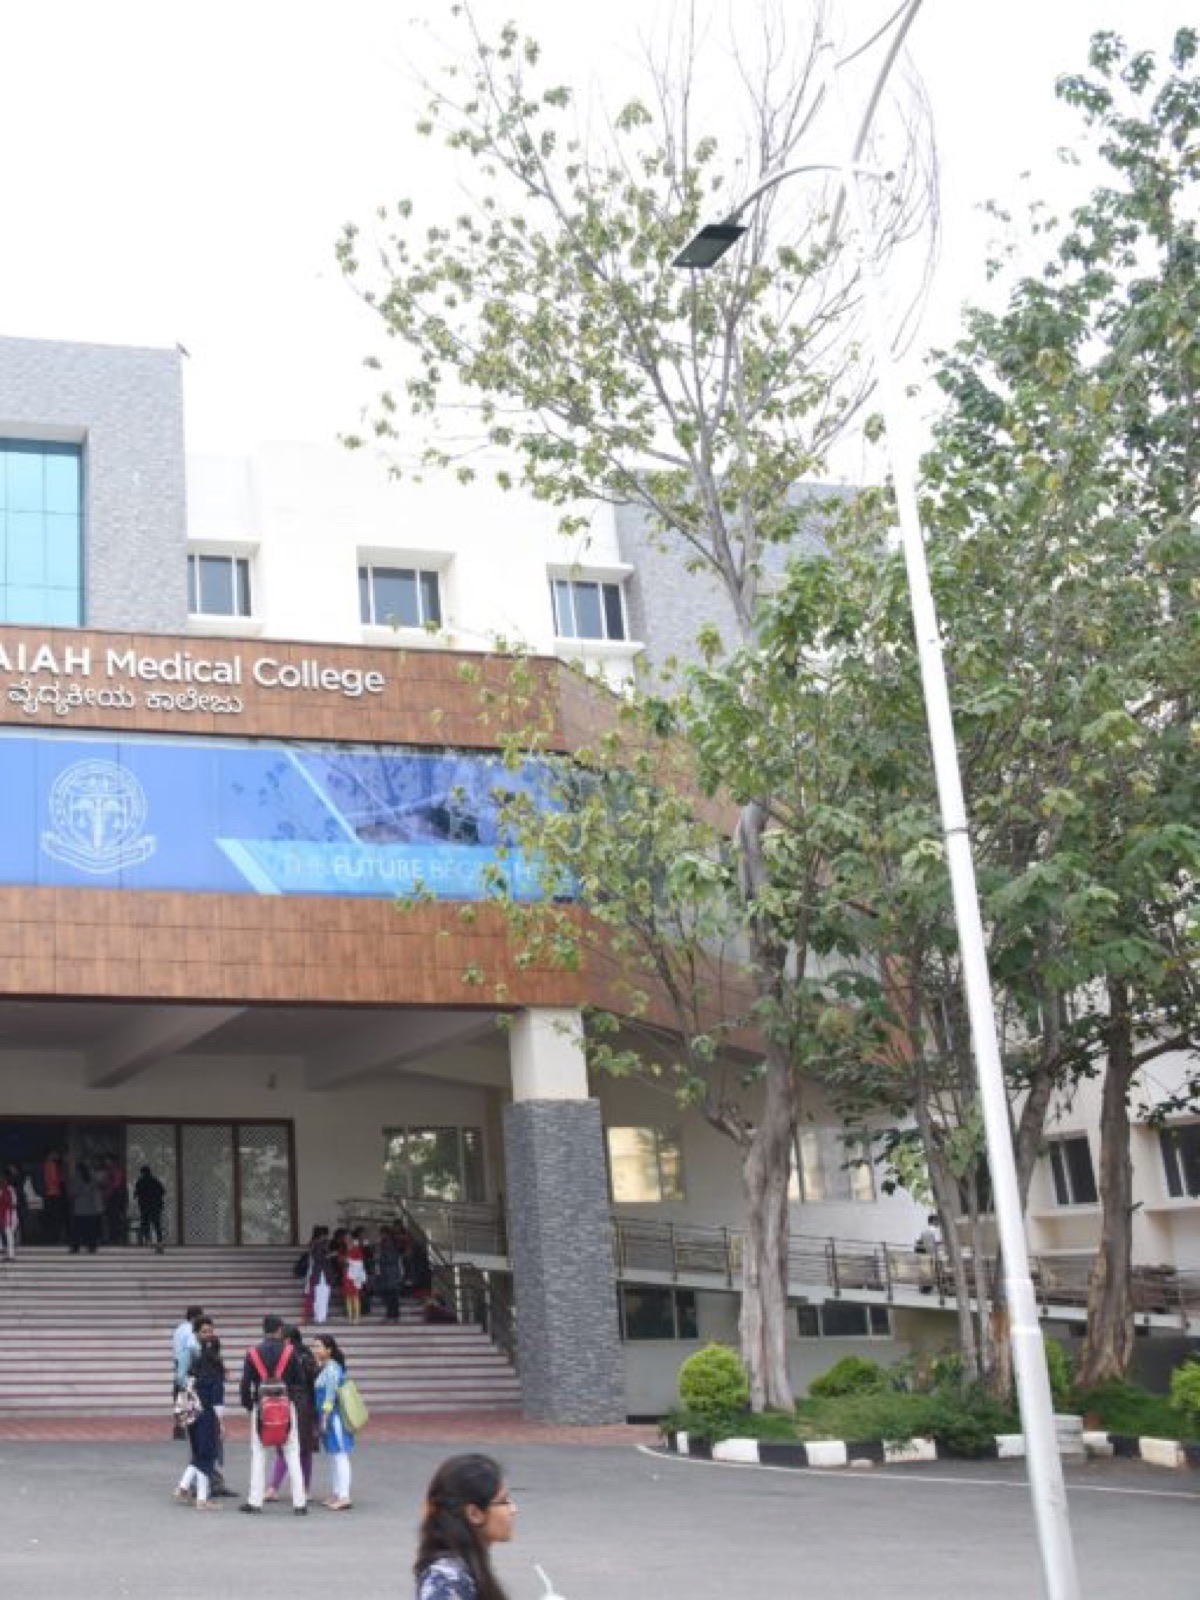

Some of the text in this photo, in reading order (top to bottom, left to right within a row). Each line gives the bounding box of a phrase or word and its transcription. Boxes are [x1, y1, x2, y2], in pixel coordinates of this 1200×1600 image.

[106, 648, 242, 684] Medical
[252, 656, 386, 697] College
[7, 678, 135, 716] ವೈದ್ಯಕೀಯ
[145, 686, 245, 714] ಕಾಲೇಜು
[334, 854, 424, 880] FUTURE
